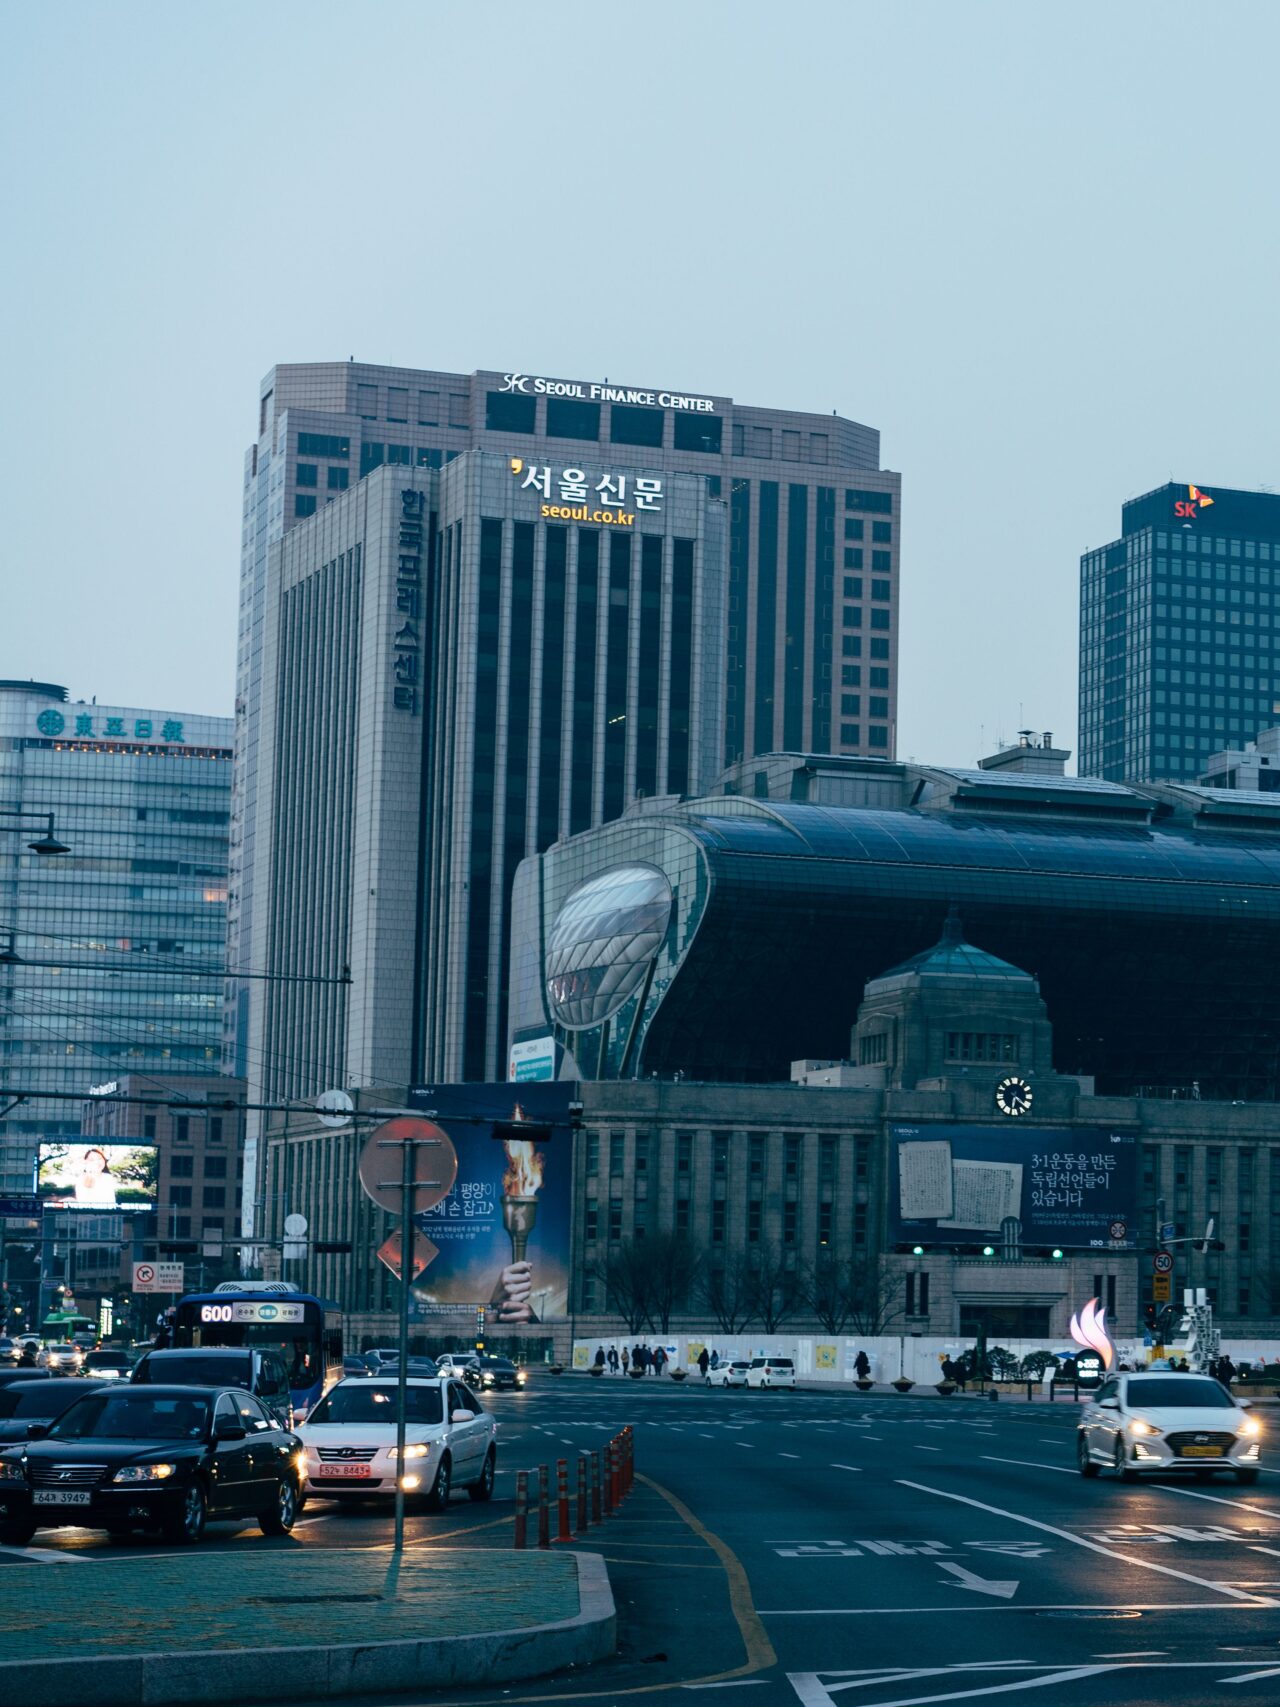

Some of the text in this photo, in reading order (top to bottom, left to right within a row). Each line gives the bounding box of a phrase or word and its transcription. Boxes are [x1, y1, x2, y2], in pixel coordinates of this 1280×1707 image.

[520, 465, 664, 511] 서울신문
[541, 504, 635, 525] seoul.co.kr
[1174, 500, 1197, 519] SK
[393, 488, 425, 717] 한국프레스센터
[1091, 1153, 1117, 1170] 만든
[1031, 1171, 1109, 1190] 독립선언들이
[460, 1182, 496, 1199] 평양이
[1031, 1189, 1084, 1207] 있습니다
[1158, 1256, 1170, 1268] 50
[201, 1305, 232, 1322] 600
[60, 1492, 86, 1503] 3949
[764, 1539, 1054, 1558] 숭례문
